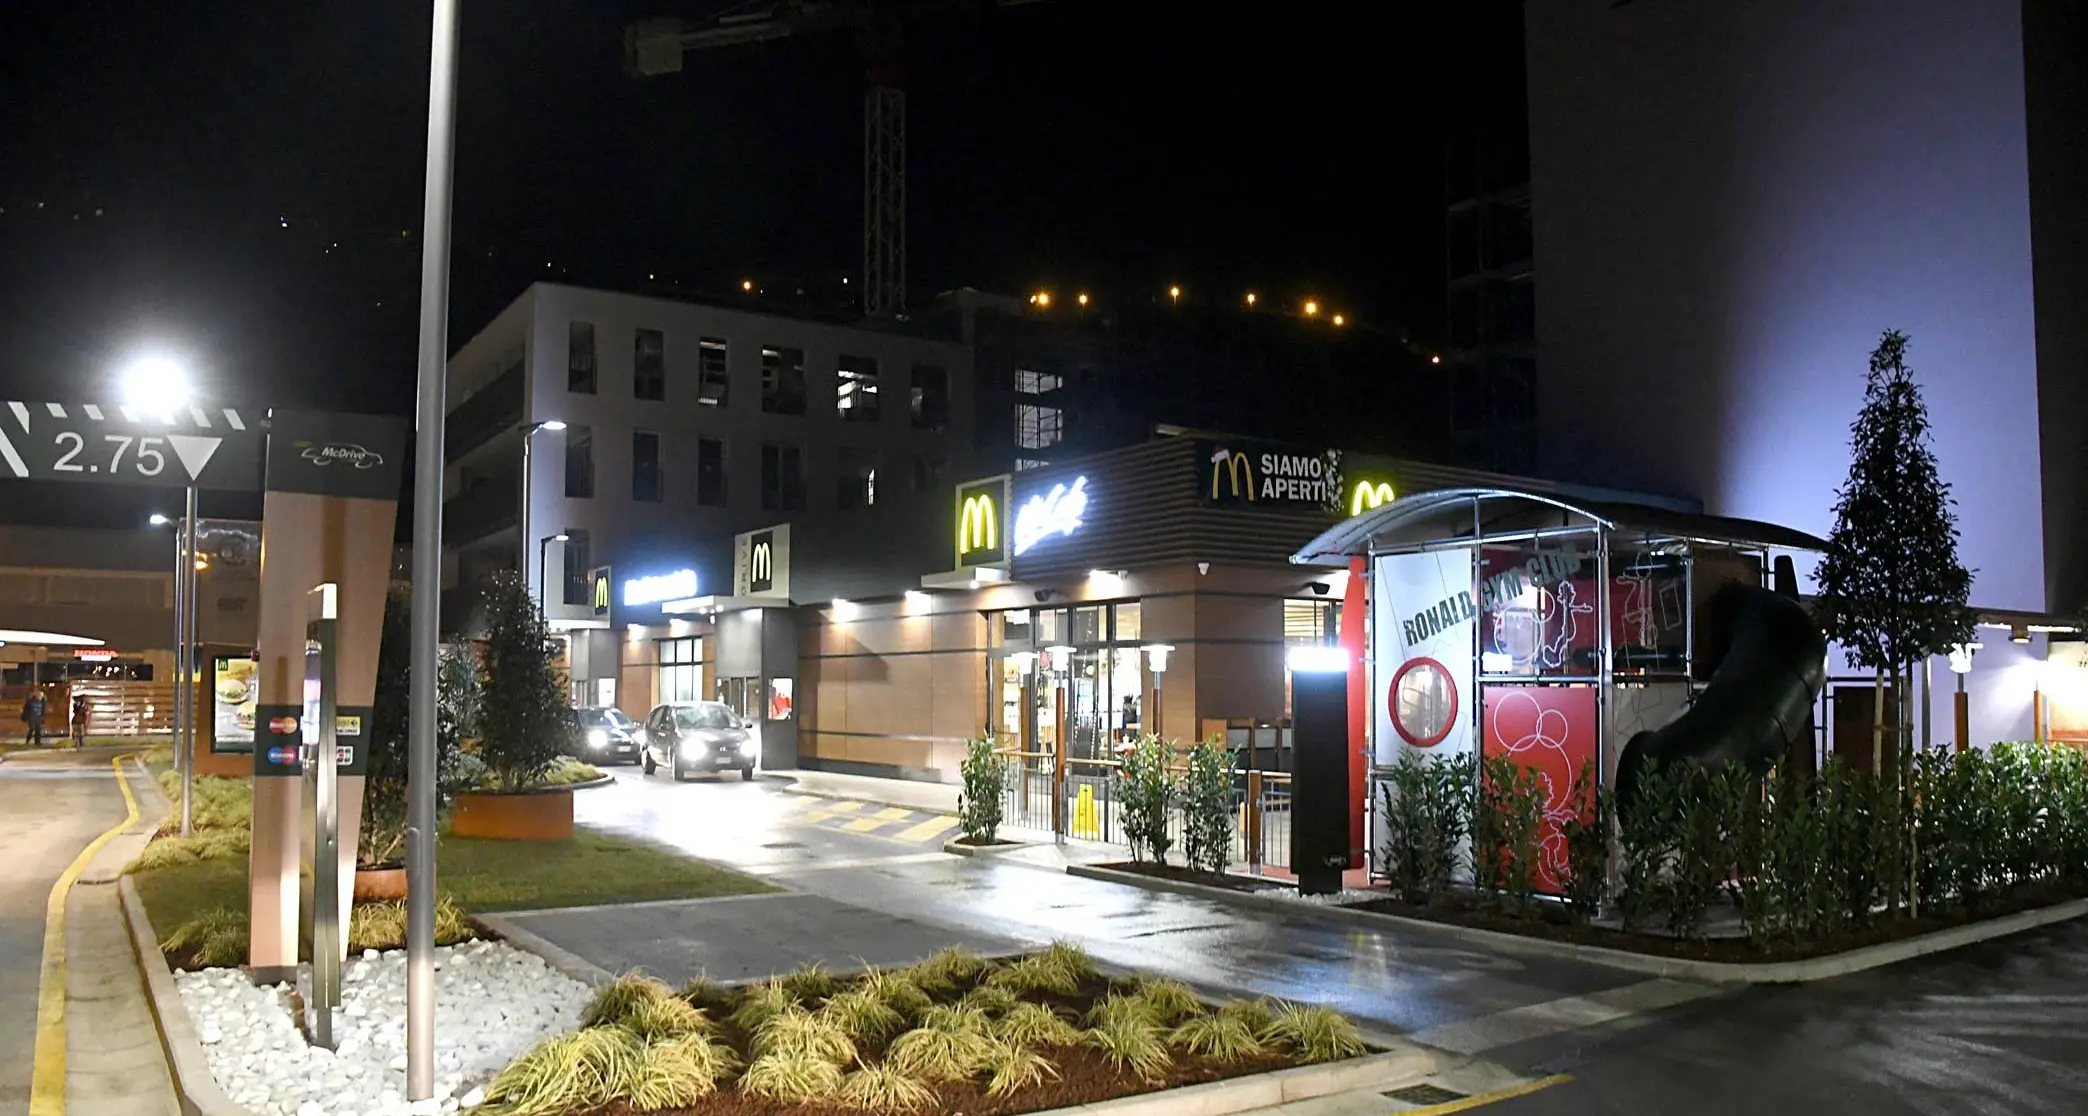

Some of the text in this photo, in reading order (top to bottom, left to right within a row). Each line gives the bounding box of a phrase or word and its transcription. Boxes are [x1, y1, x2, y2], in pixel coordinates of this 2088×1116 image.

[53, 431, 166, 476] 2.75
[321, 446, 366, 461] McDrive
[1260, 453, 1322, 479] SIAMO
[1261, 477, 1327, 501] APERTI
[1403, 542, 1582, 647] RONALD GYM CLUB
